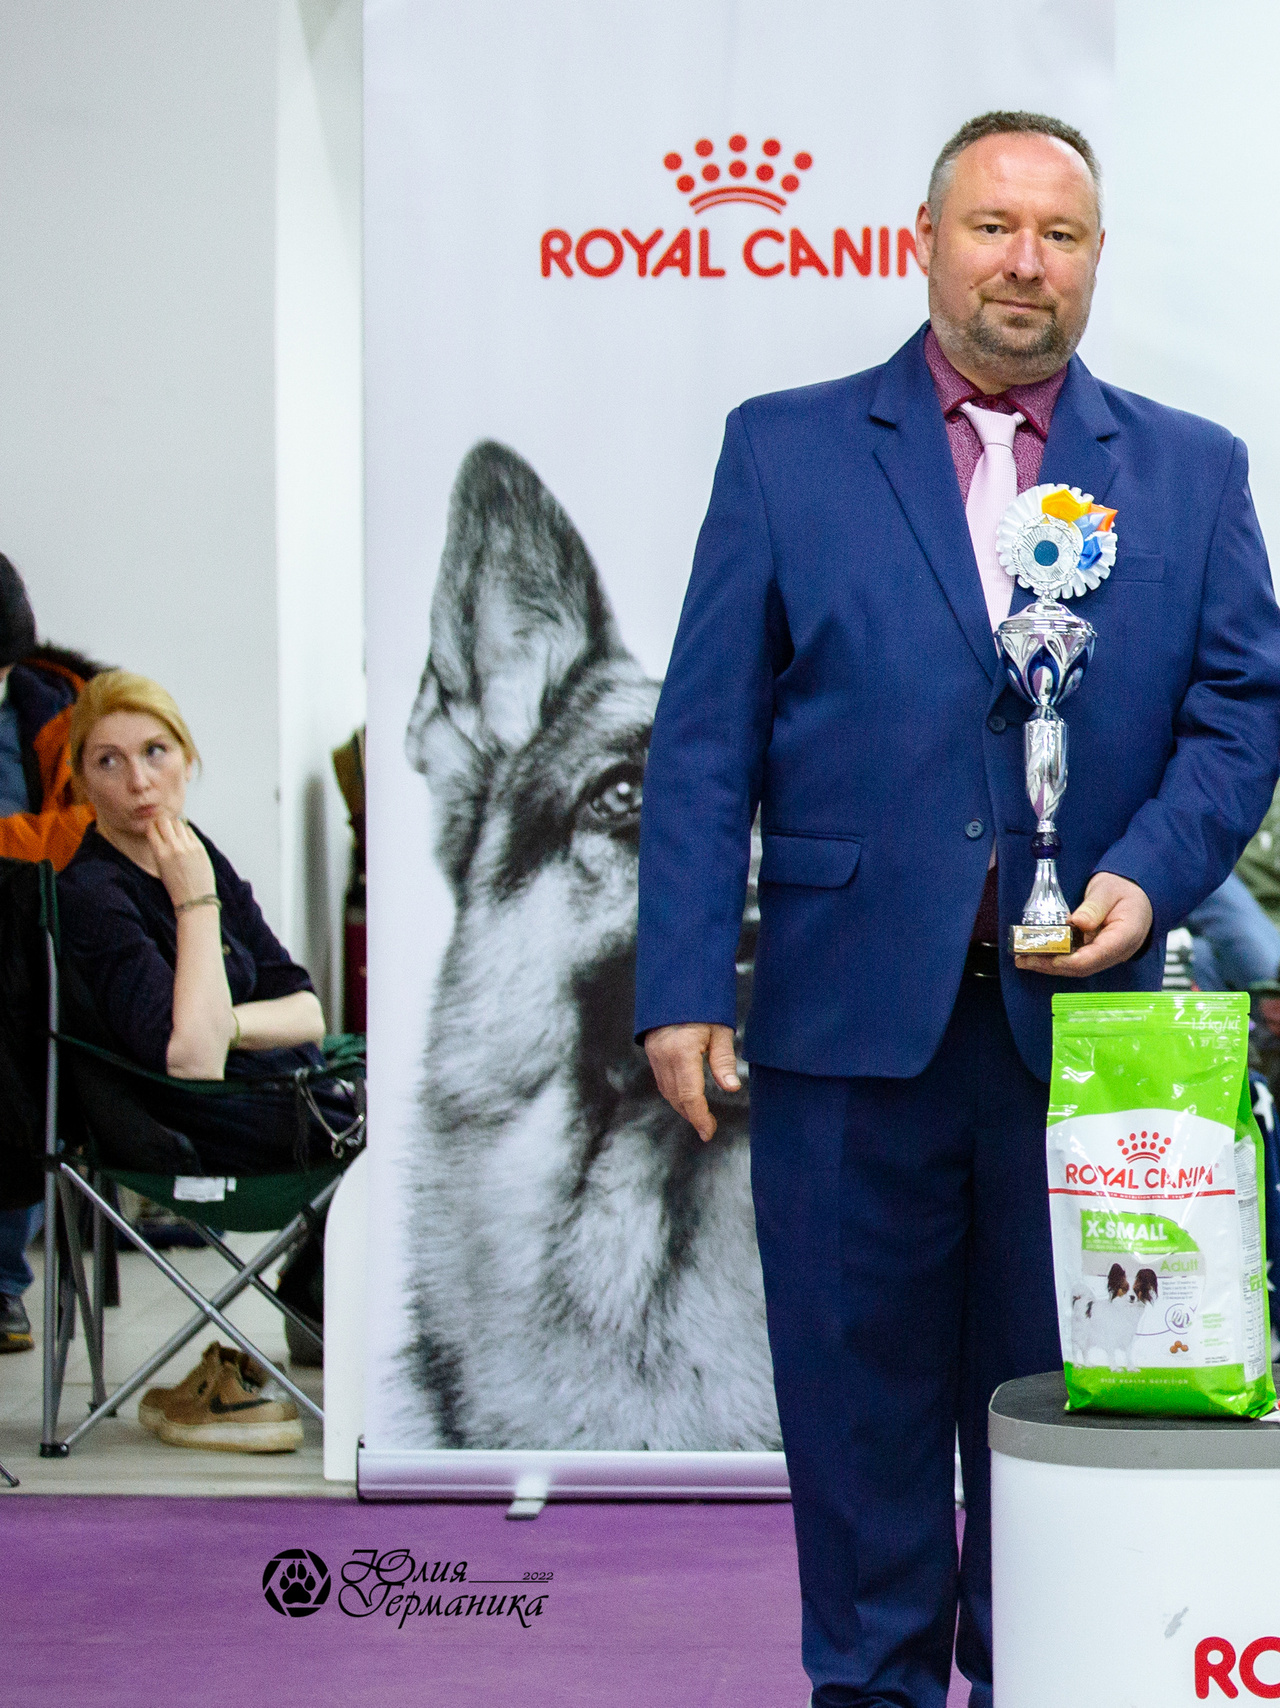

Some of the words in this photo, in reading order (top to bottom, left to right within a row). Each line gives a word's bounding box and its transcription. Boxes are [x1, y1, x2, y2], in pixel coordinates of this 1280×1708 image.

[540, 227, 726, 278] ROYAL
[1066, 1163, 1139, 1190] ROYAL
[1145, 1165, 1213, 1190] CANIN
[1085, 1219, 1168, 1241] X-SMALL
[1160, 1258, 1199, 1272] Adult
